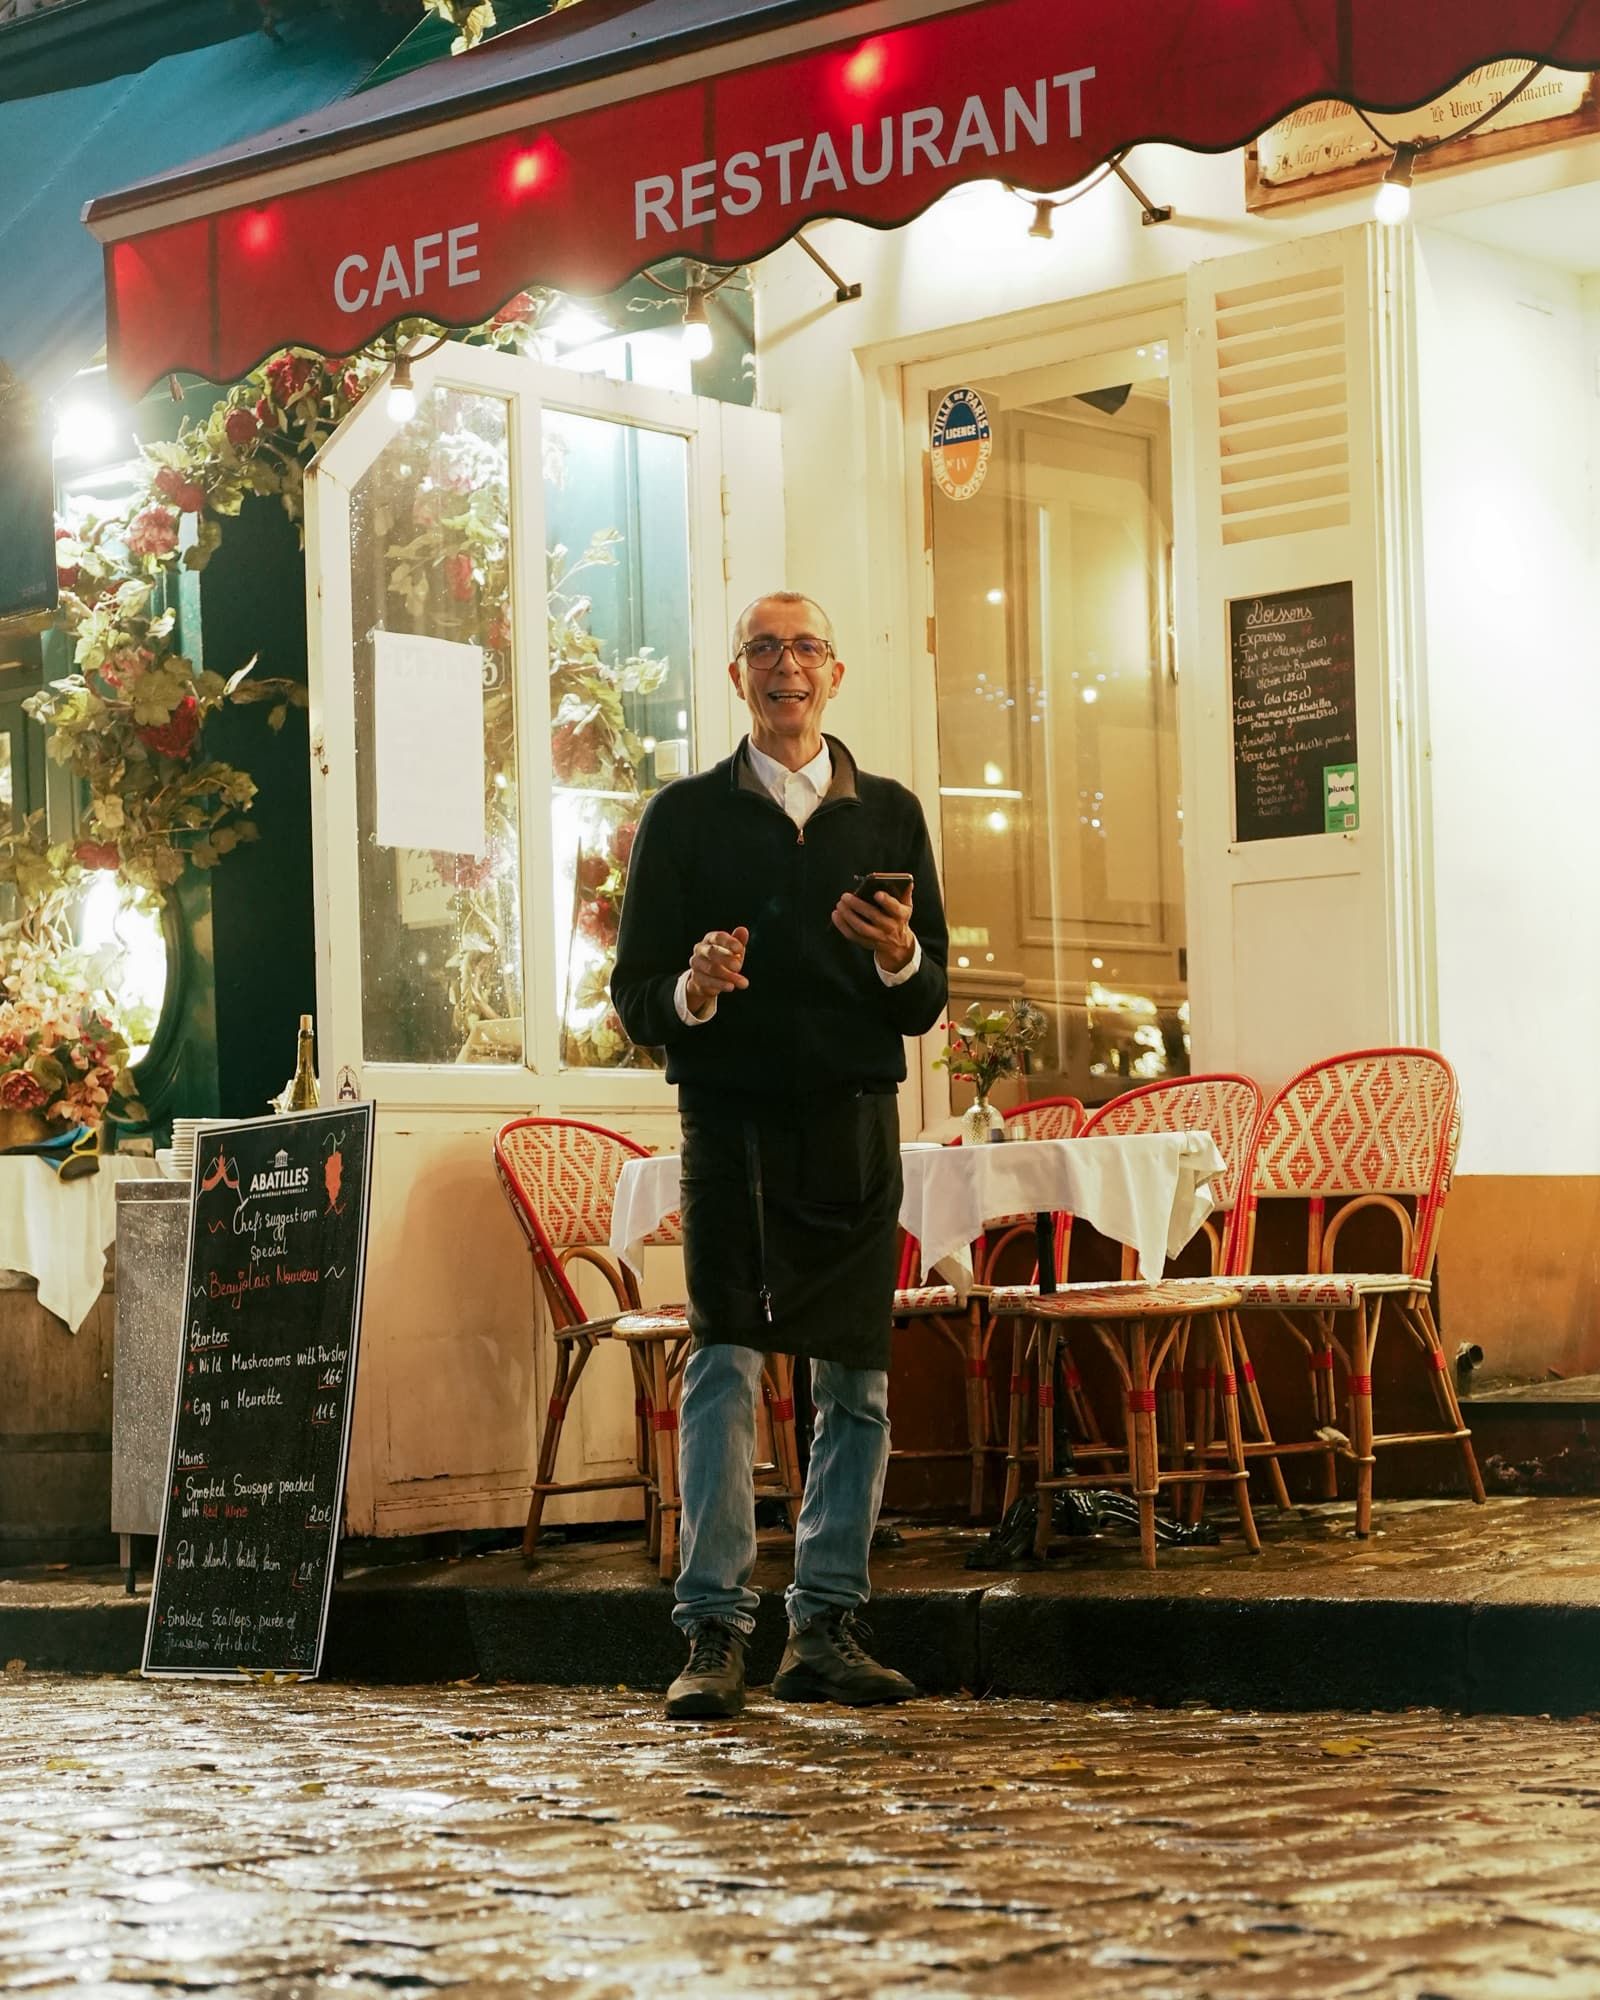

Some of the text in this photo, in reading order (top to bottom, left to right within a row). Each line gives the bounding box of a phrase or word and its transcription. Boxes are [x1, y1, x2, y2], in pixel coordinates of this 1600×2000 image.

[1449, 100, 1483, 119] Vieux
[333, 67, 1096, 314] CAFE RESTAURANT
[933, 398, 955, 437] VILLE
[965, 391, 989, 429] PARIS
[945, 424, 977, 440] LICENCE
[1247, 599, 1313, 625] Boissons
[1236, 714, 1254, 725] Eau
[250, 1167, 309, 1193] ABATILLES
[199, 1355, 222, 1374] Wild
[232, 1351, 291, 1371] Mushrooms
[297, 1346, 316, 1366] with
[193, 1386, 283, 1426] Egg in Meurette
[185, 1473, 315, 1506] Smoked Sausage poached
[182, 1503, 199, 1519] with
[202, 1504, 219, 1519] Red
[309, 1504, 331, 1523] 20€
